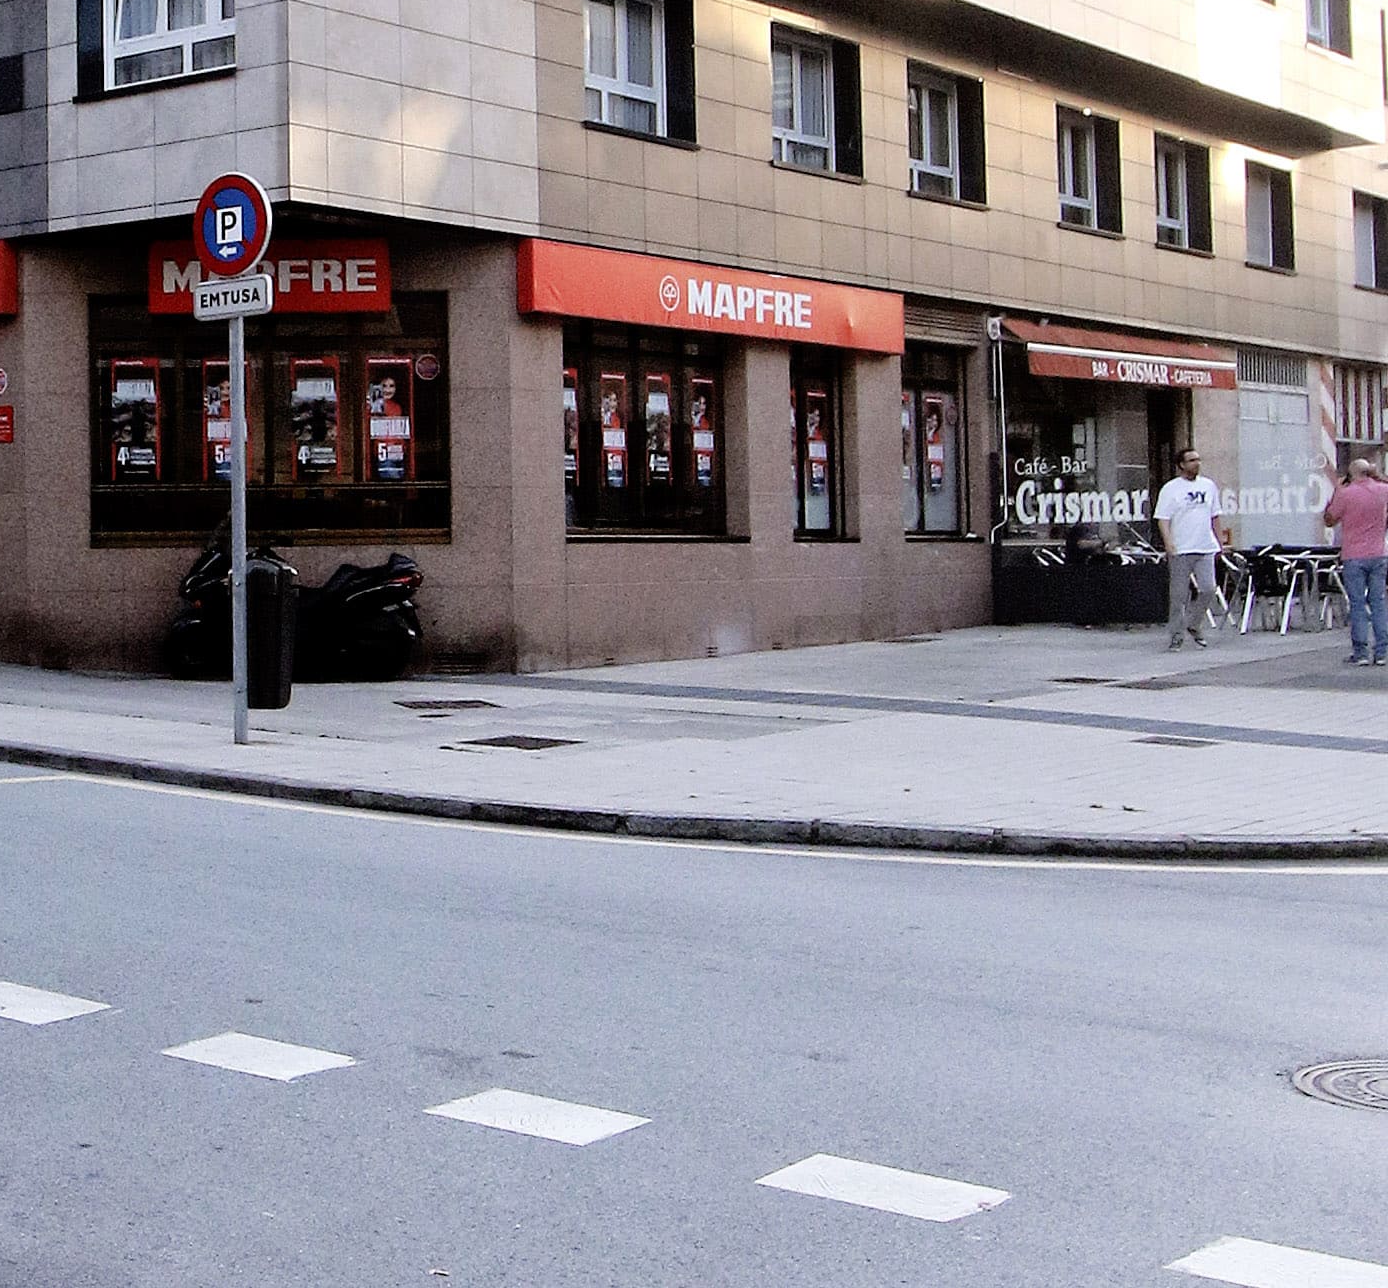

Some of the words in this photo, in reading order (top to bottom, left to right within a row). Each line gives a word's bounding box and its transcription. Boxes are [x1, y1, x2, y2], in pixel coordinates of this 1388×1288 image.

[220, 210, 237, 241] P
[163, 259, 377, 293] MFRE
[200, 287, 261, 309] EMTUSA
[687, 278, 812, 329] MAPFRE
[1091, 360, 1109, 378] BAR
[1117, 360, 1170, 385] CRISMAR
[1014, 456, 1049, 476] Café
[1061, 455, 1088, 474] Bar
[1016, 477, 1150, 525] Crismar
